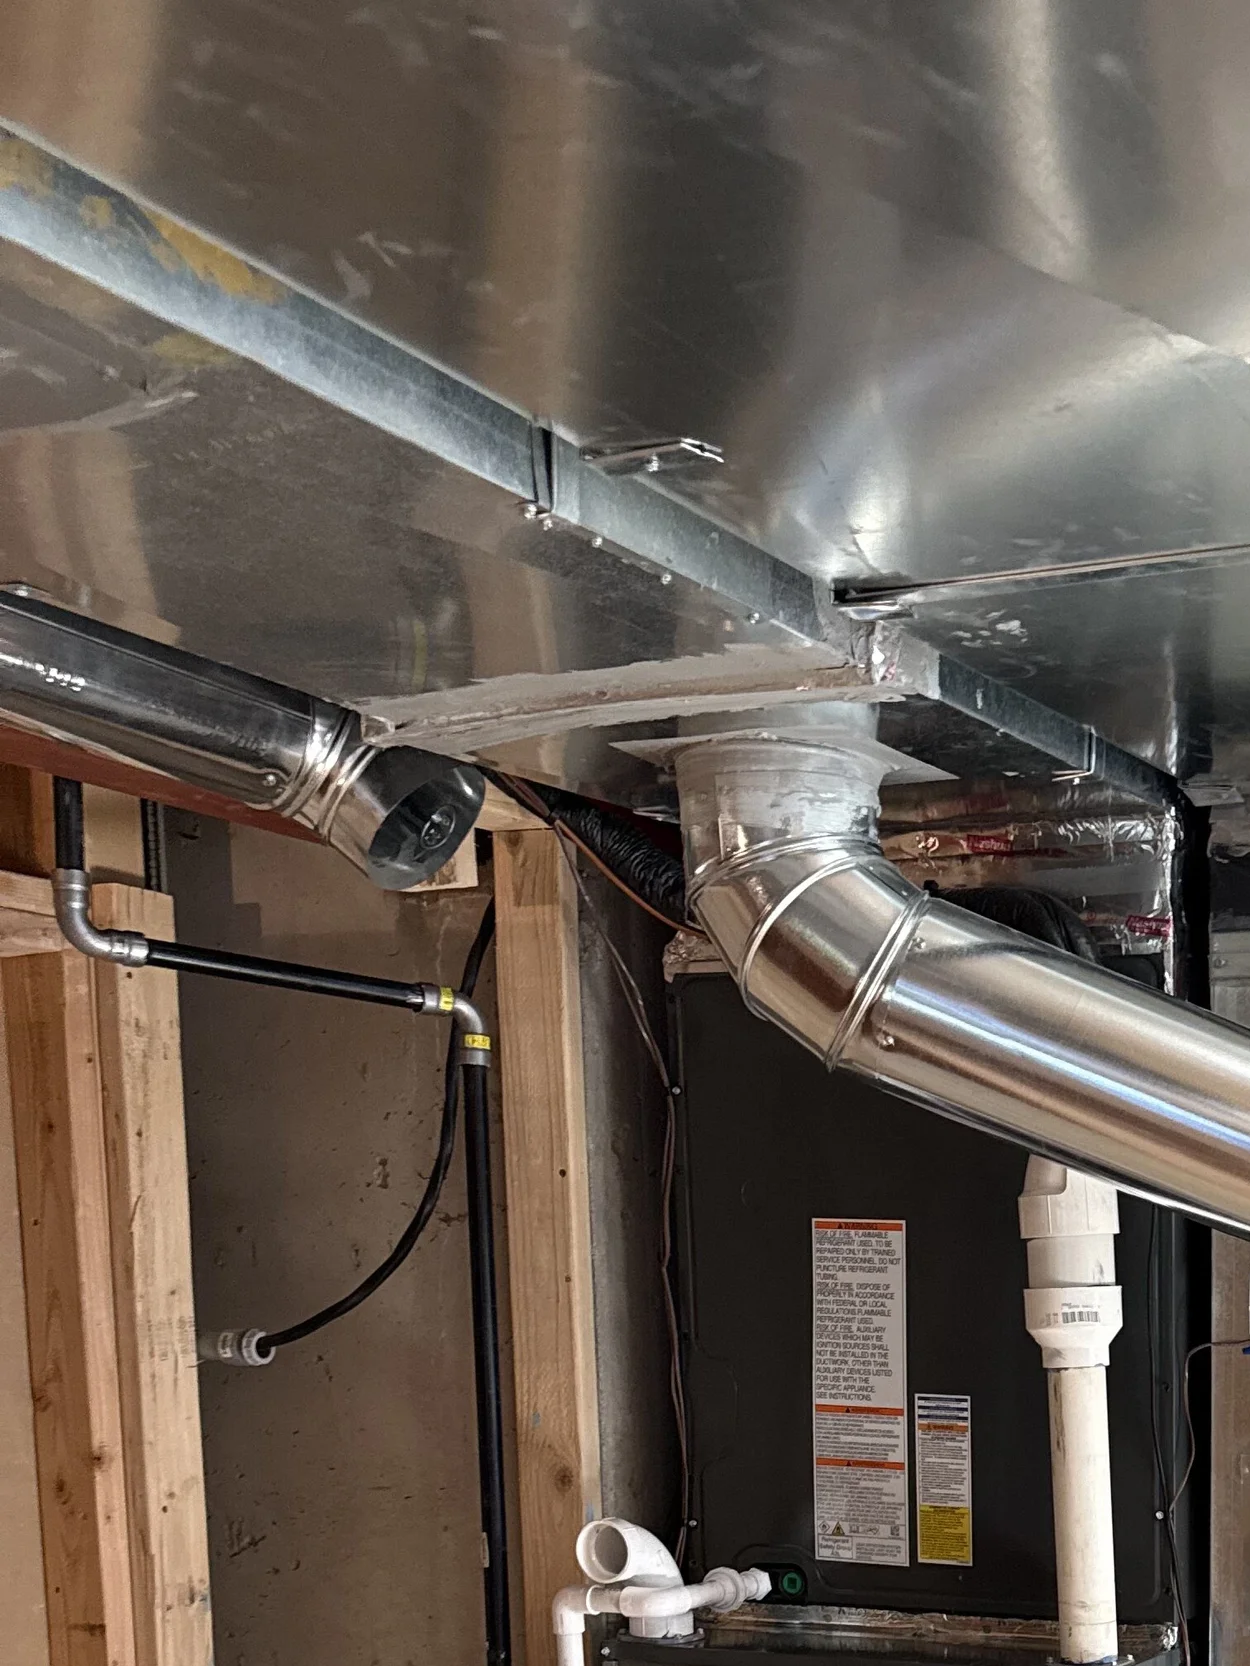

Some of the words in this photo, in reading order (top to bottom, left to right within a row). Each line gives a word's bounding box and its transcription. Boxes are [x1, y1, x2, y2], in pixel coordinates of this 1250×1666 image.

[816, 1316, 856, 1324] REFRIGERANT
[816, 1341, 841, 1349] IGNITION
[843, 1342, 870, 1350] SOURCES
[872, 1343, 889, 1351] SHALL
[846, 1368, 871, 1376] DEVICES
[872, 1369, 892, 1377] LISTED
[816, 1383, 841, 1391] SPECIFIC
